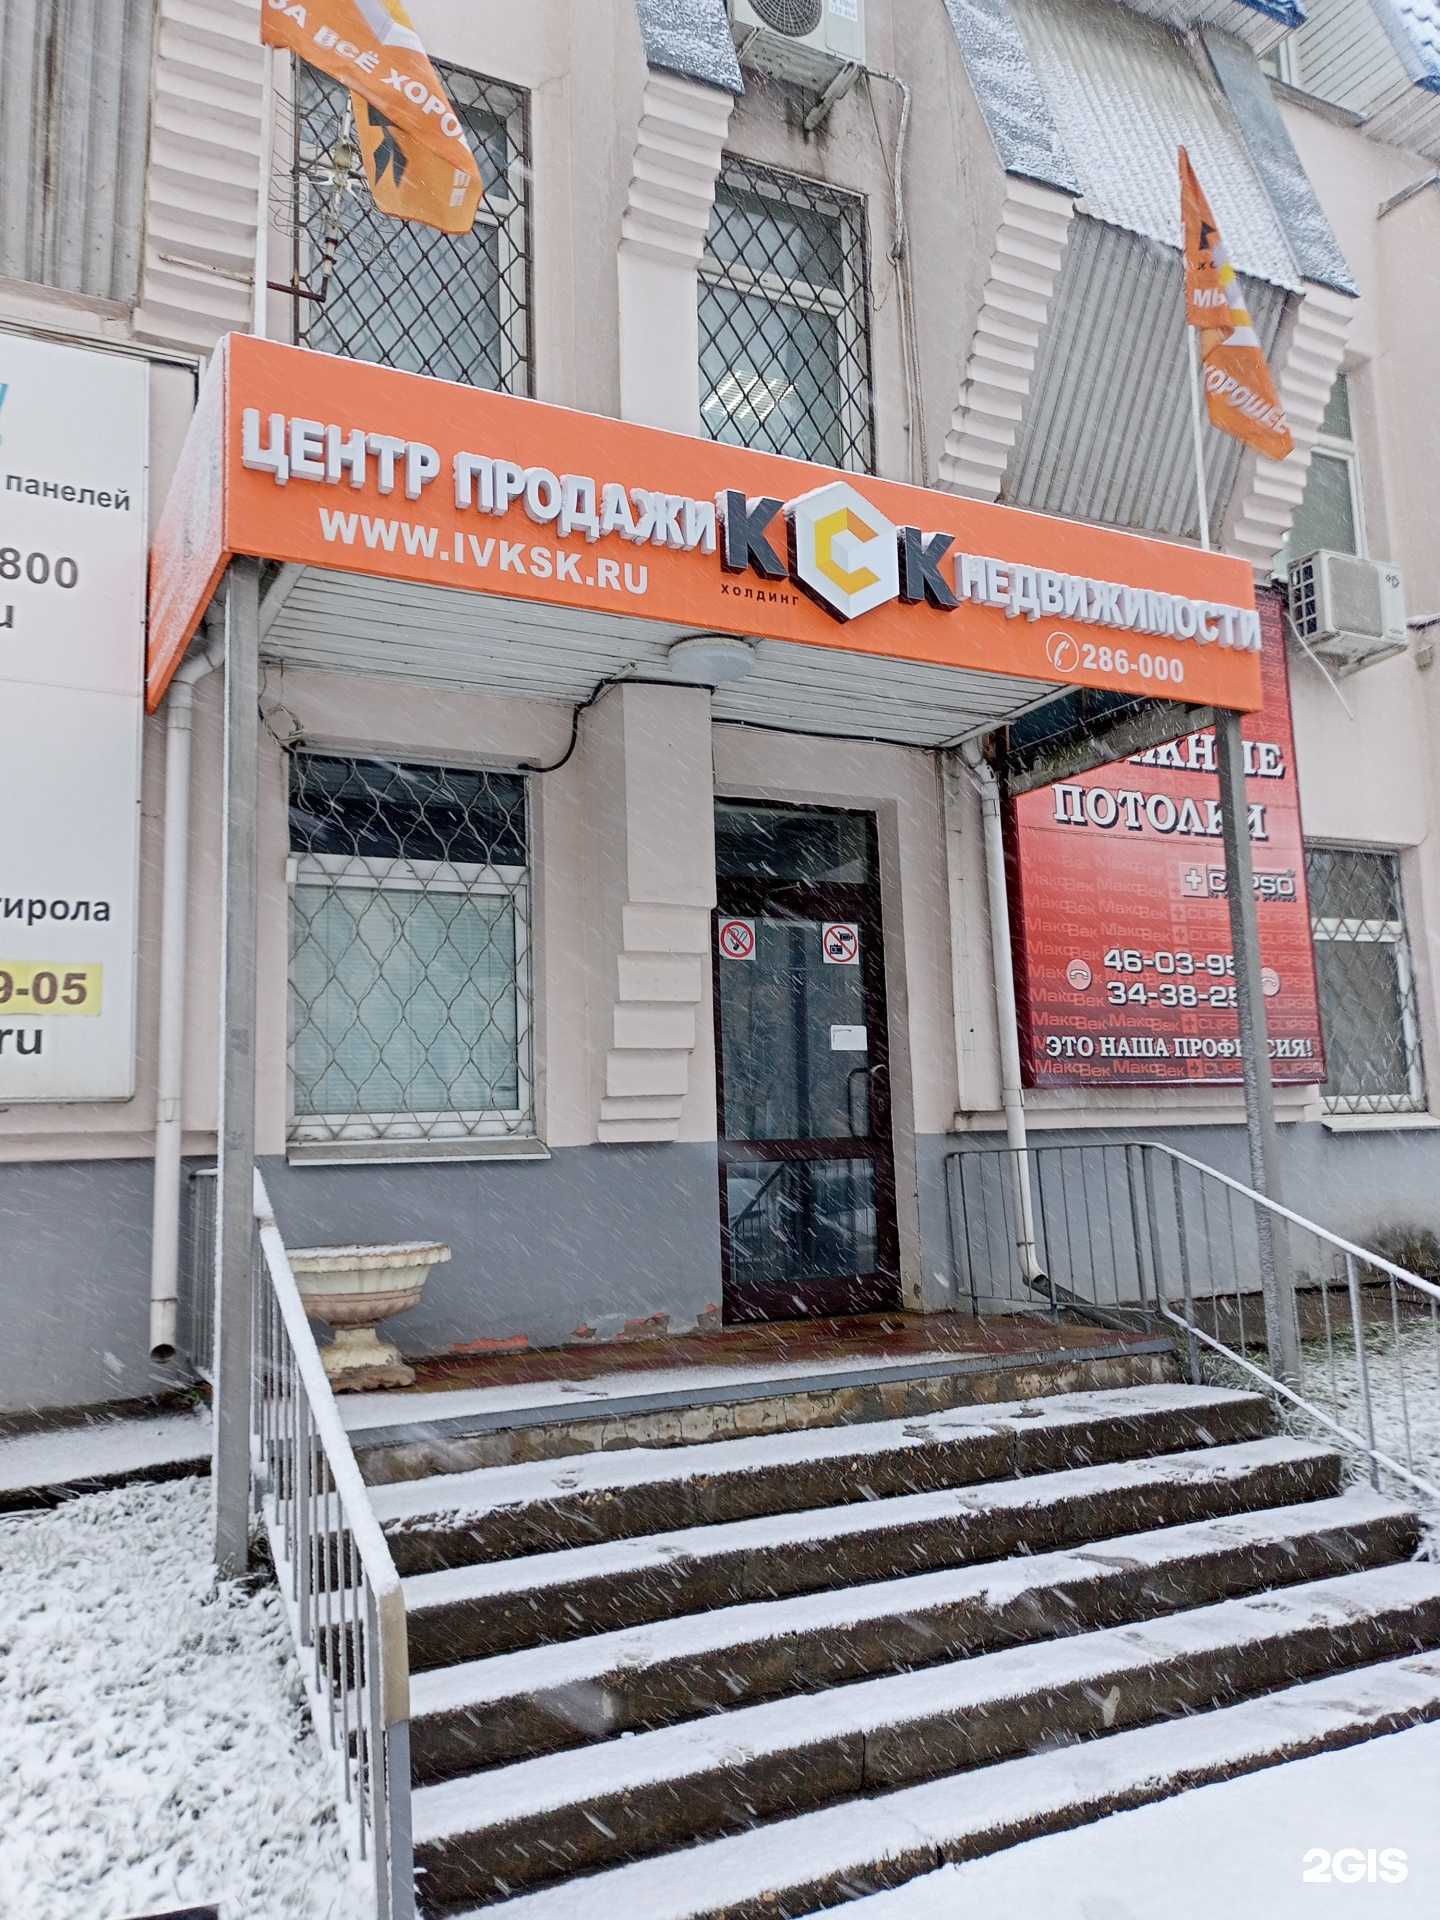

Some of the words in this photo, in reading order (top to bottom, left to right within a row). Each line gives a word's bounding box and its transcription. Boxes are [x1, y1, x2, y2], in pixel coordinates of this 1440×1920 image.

[313, 26, 380, 74] ВСЁ
[6, 474, 130, 511] панелей
[242, 408, 441, 500] ЦЕНТР
[453, 451, 717, 555] ПРОДАЖИ
[954, 551, 1262, 652] НЕДВИЖИМОСТИ
[0, 547, 78, 589] 800
[318, 507, 650, 595] WWW.IVKSK.RU
[1082, 643, 1185, 684] 286-000
[0, 897, 111, 926] ирола
[1046, 1036, 1094, 1057] ЭТО
[1099, 1036, 1169, 1058] НАША
[1172, 1037, 1313, 1058] ПРОФСИЯ!
